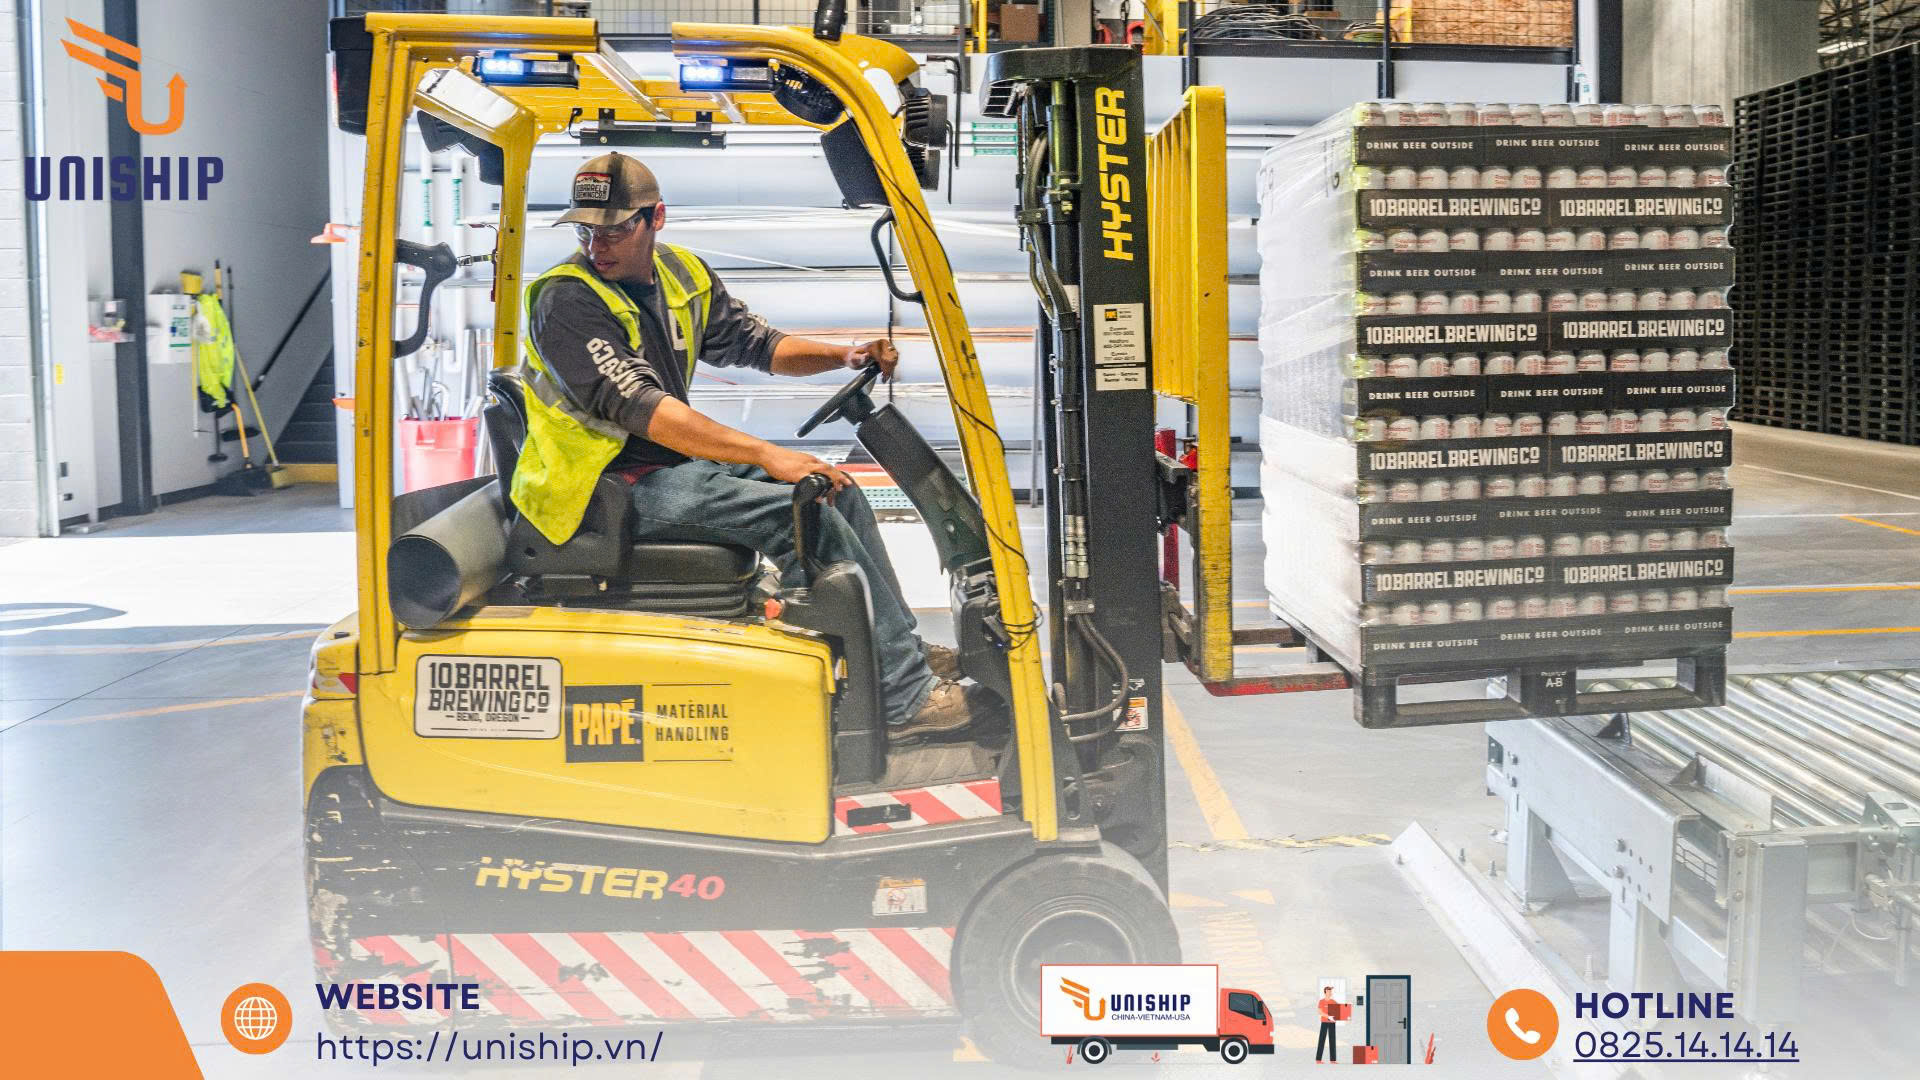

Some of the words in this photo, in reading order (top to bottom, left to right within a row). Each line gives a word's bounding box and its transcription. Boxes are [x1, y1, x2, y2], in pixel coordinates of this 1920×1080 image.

[1366, 142, 1398, 150] DRINK
[1431, 141, 1474, 149] OUTSIDE
[1496, 139, 1527, 147] DRINK
[1531, 139, 1554, 147] BEER
[1559, 139, 1600, 147] OUTSIDE
[1095, 87, 1134, 261] HYSTER
[1406, 269, 1429, 277] BEER
[1434, 269, 1476, 277] OUTSIDE
[1500, 268, 1531, 276] DRINK
[1536, 268, 1558, 276] BEER
[1369, 392, 1401, 400] DRINK
[1433, 390, 1475, 398] OUTSIDE
[1500, 390, 1531, 398] DRINK
[1536, 389, 1558, 397] BEER
[1563, 388, 1604, 396] OUTSIDE
[1627, 387, 1657, 395] DRINK
[1562, 508, 1602, 516] OUTSIDE
[1686, 507, 1725, 515] OUTSIDE
[1371, 518, 1402, 526] DRINK
[1435, 515, 1477, 523] OUTSIDE
[1625, 626, 1654, 634] DRINK
[1684, 622, 1723, 630] OUTSIDE
[1562, 629, 1602, 638] OUTSIDE
[1373, 643, 1405, 651] DRINK
[1409, 641, 1433, 649] BEER
[1437, 640, 1479, 648] OUTSIDE
[1545, 677, 1563, 688] A-B
[656, 704, 729, 719] MATERIAL
[486, 712, 519, 722] OREGON
[572, 699, 636, 746] PAPÉ
[656, 726, 729, 742] HANDLING
[475, 857, 669, 900] HYSTER
[668, 873, 726, 900] 40
